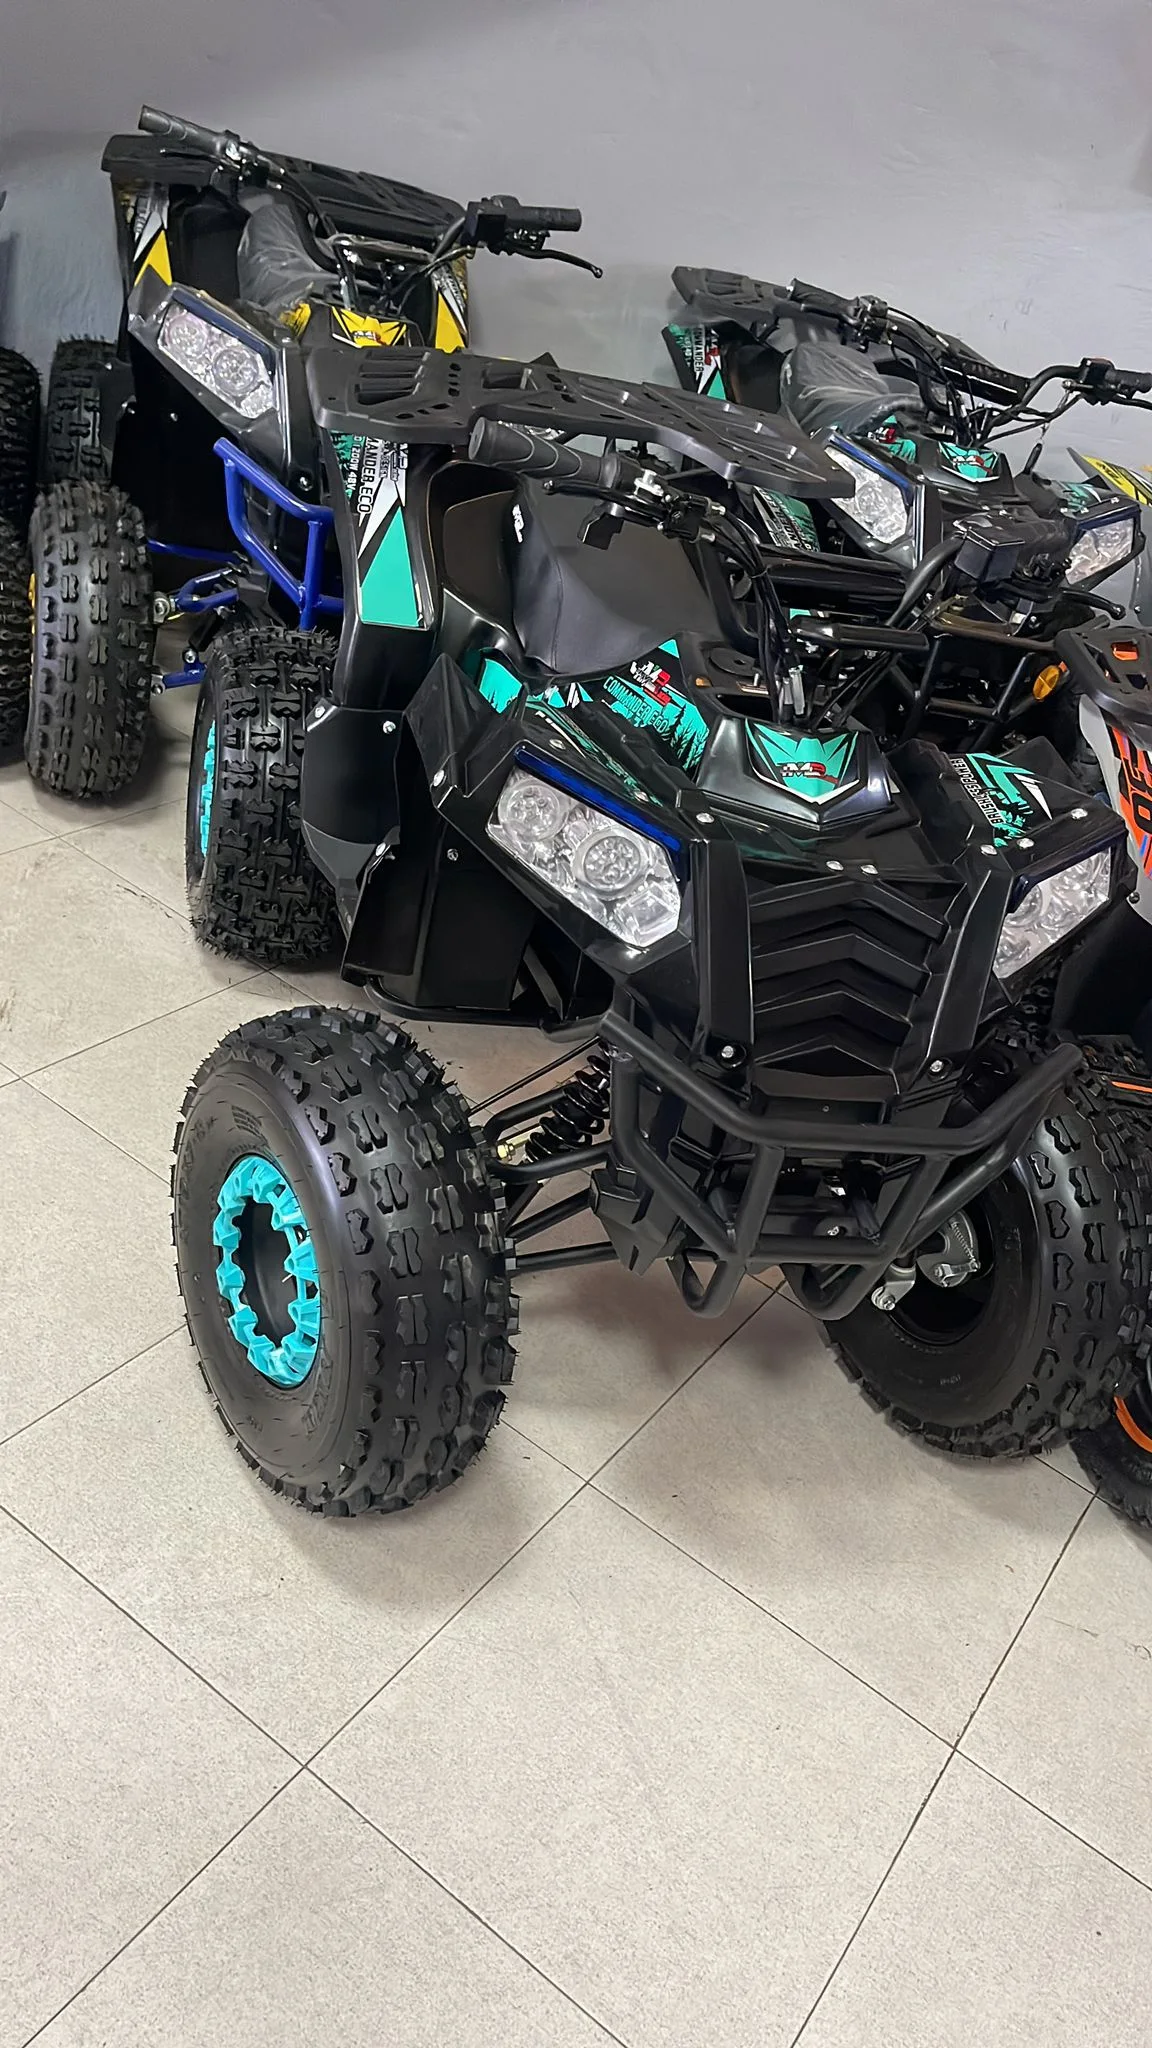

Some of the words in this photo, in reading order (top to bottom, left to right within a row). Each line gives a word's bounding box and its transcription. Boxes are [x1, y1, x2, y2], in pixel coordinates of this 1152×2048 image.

[350, 443, 360, 470] 1200W
[346, 471, 357, 491] 48V
[358, 485, 374, 513] ECO
[602, 675, 652, 720] COMMANDER
